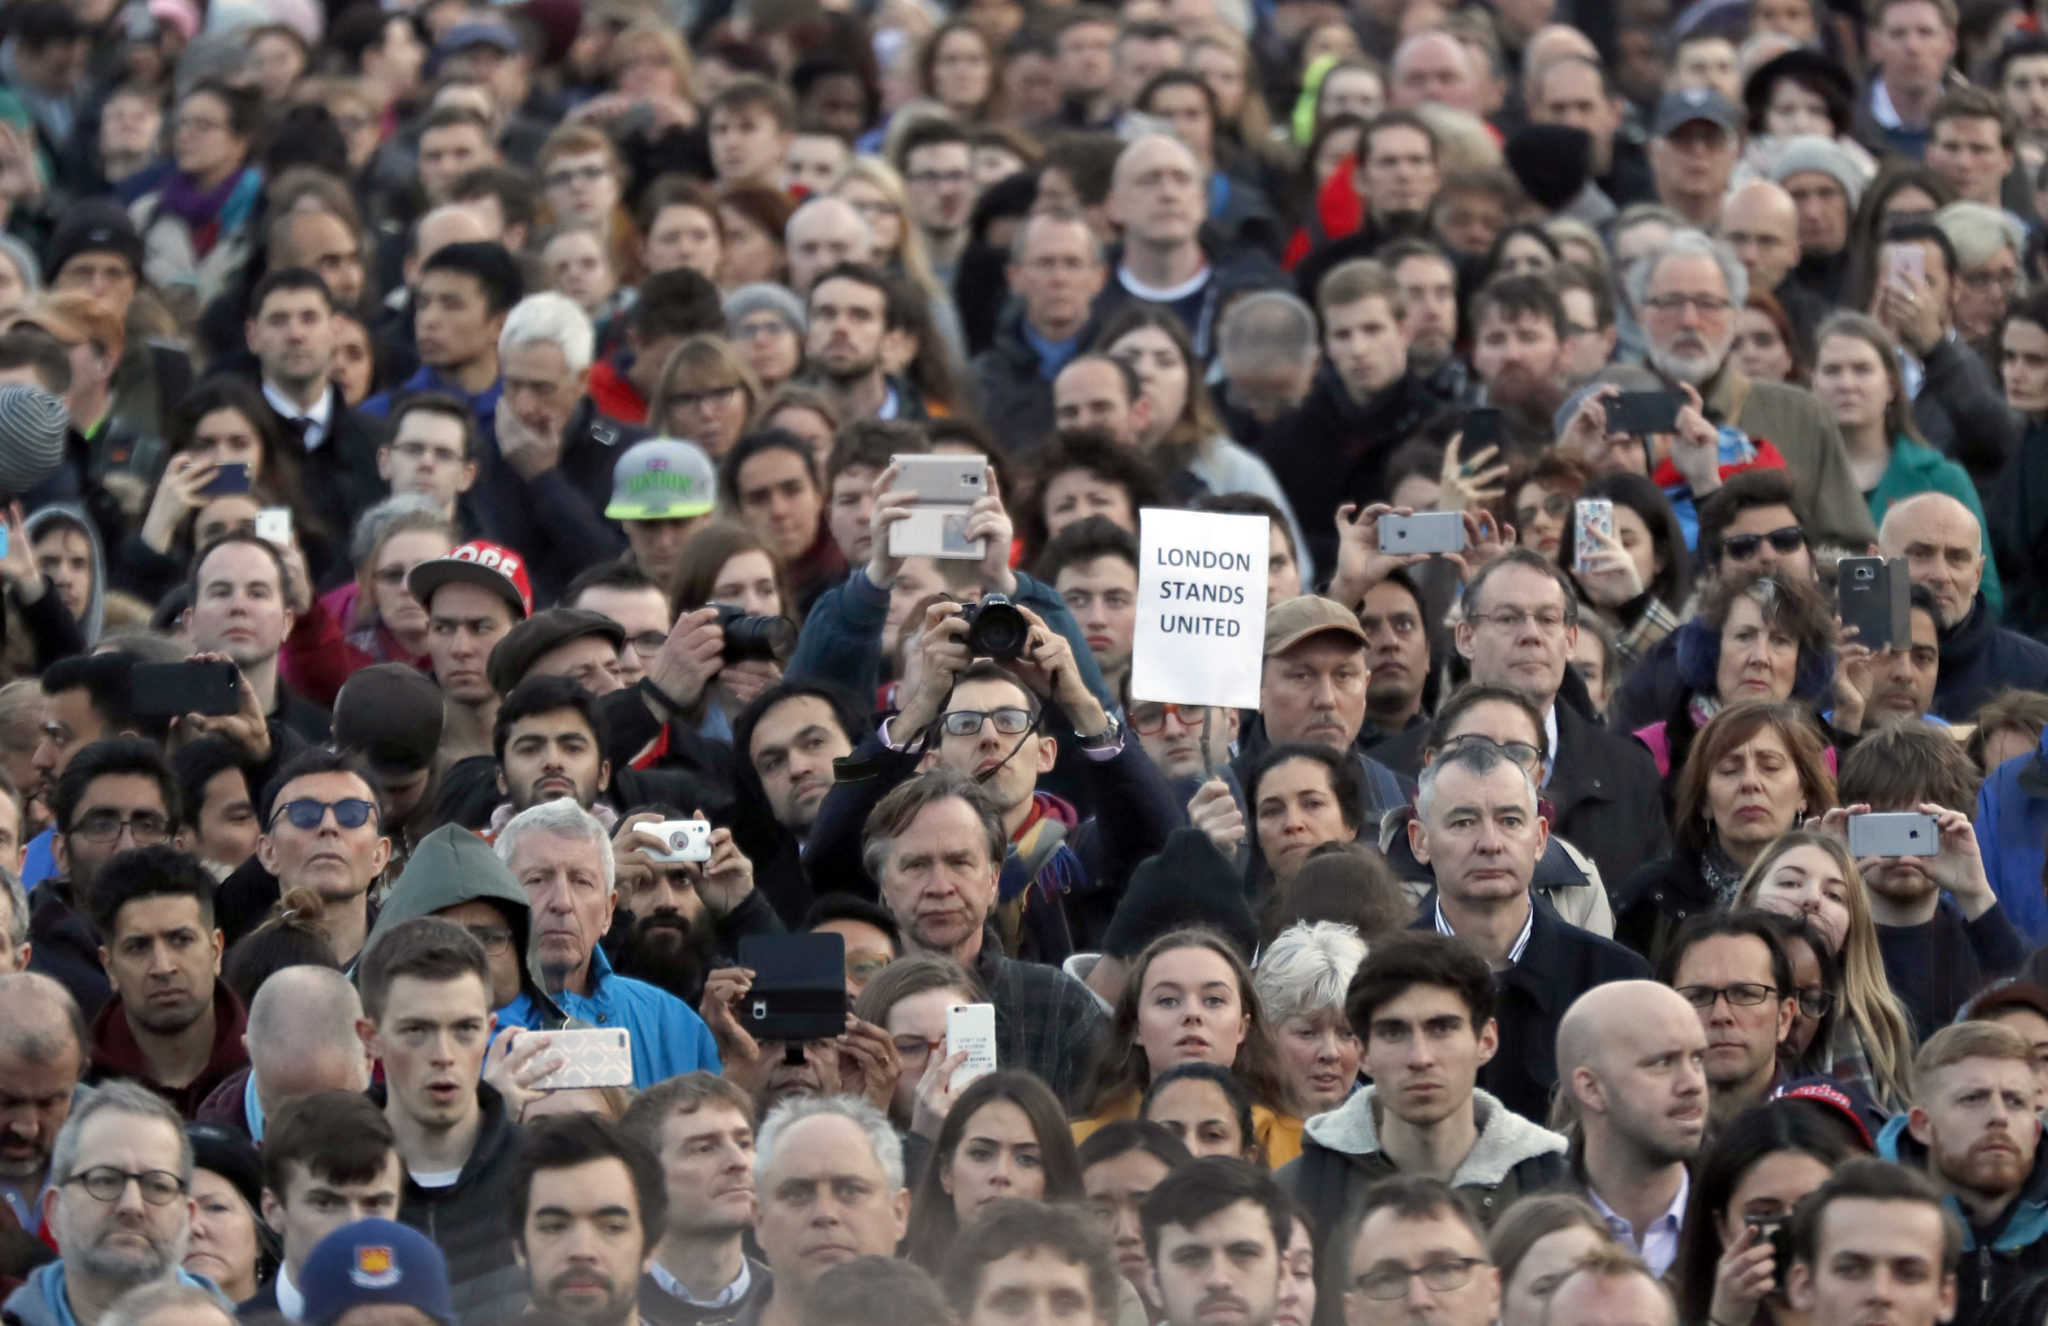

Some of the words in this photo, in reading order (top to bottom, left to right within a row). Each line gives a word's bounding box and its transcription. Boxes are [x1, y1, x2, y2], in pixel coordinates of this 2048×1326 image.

[625, 471, 692, 497] LONDON
[439, 545, 518, 578] OPE
[1157, 547, 1251, 572] LONDON
[1159, 580, 1244, 605] STANDS
[1160, 614, 1240, 638] UNITED
